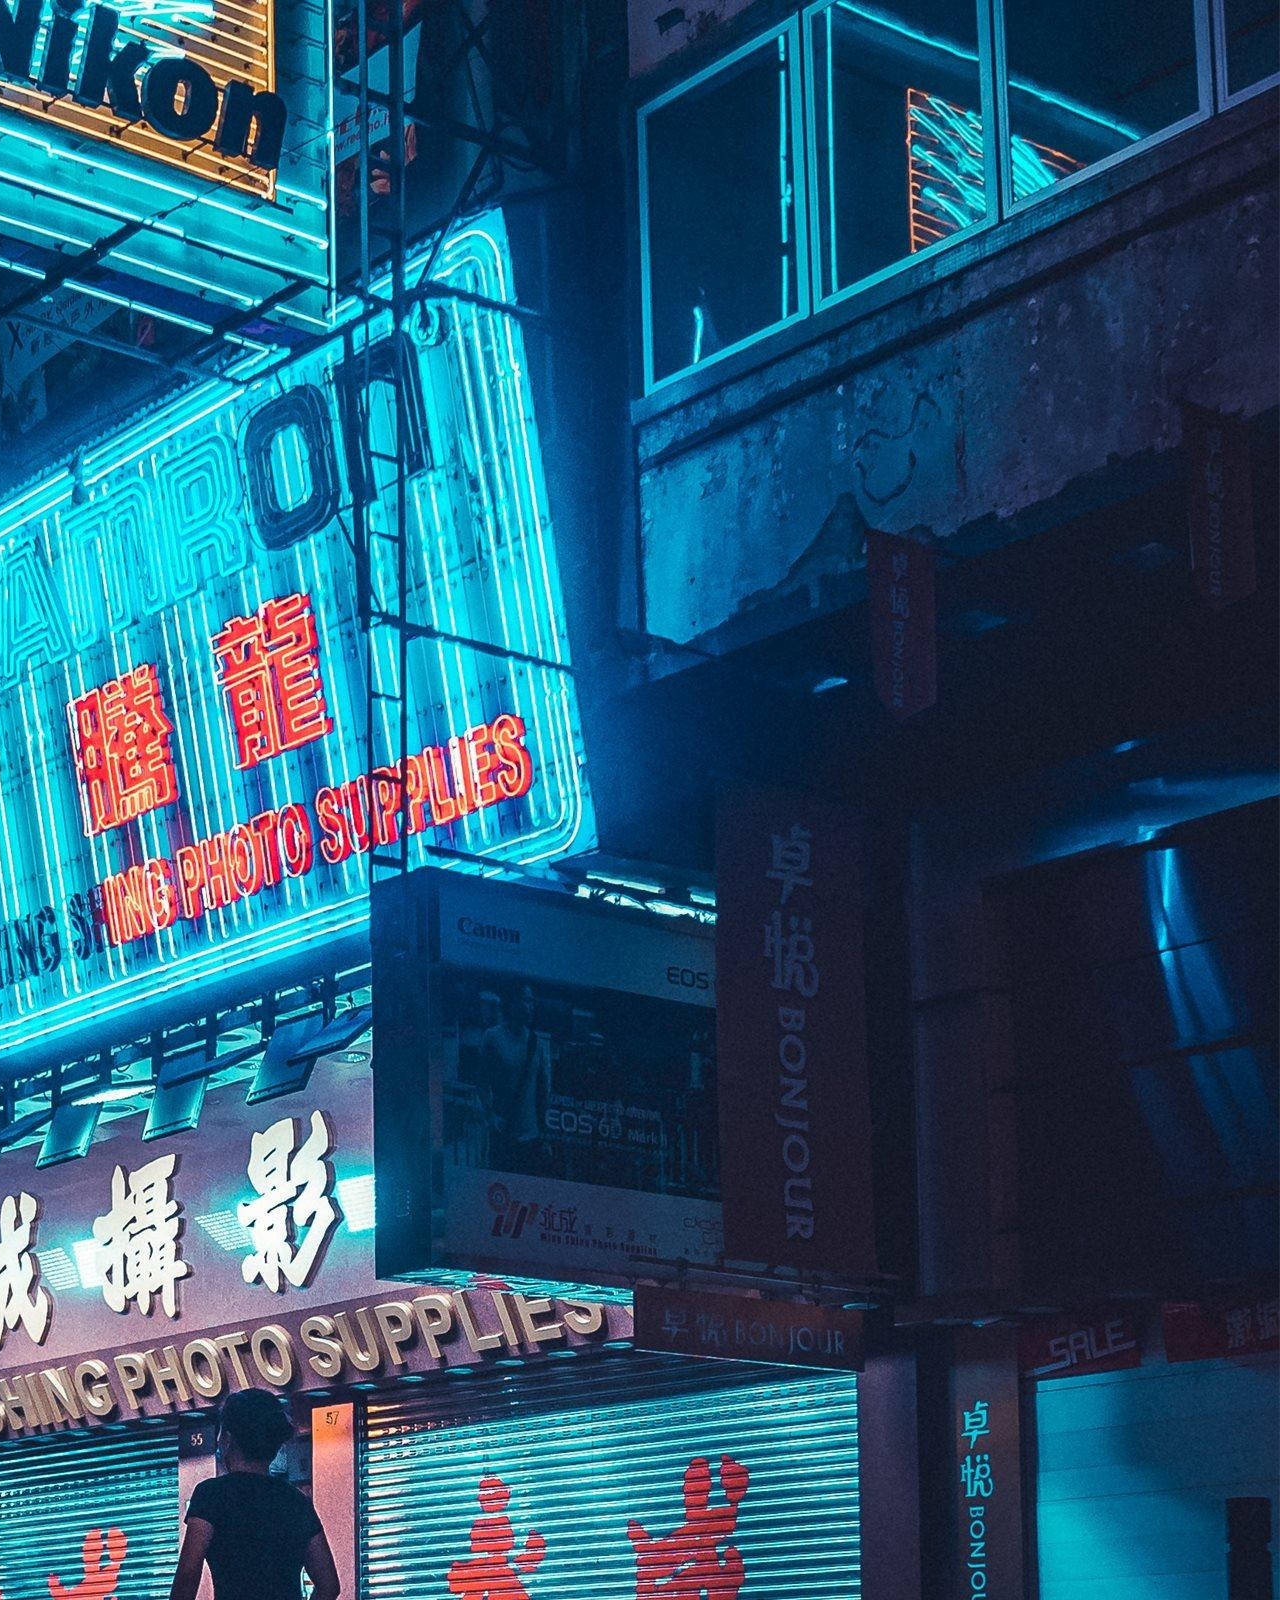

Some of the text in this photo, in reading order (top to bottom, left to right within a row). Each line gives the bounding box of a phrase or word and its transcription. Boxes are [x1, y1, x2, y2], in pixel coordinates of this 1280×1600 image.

[176, 801, 315, 919] PHOTO
[315, 713, 532, 864] SUPPLIES
[457, 916, 520, 944] Canon
[666, 966, 711, 990] EOS
[545, 1108, 593, 1135] EOS
[776, 1006, 815, 1240] BONJOUR
[735, 1319, 844, 1355] BONJOUR
[1030, 1319, 1137, 1376] SALE
[118, 1323, 295, 1410] PHOTO
[325, 1410, 340, 1427] 57
[190, 1433, 203, 1447] 55
